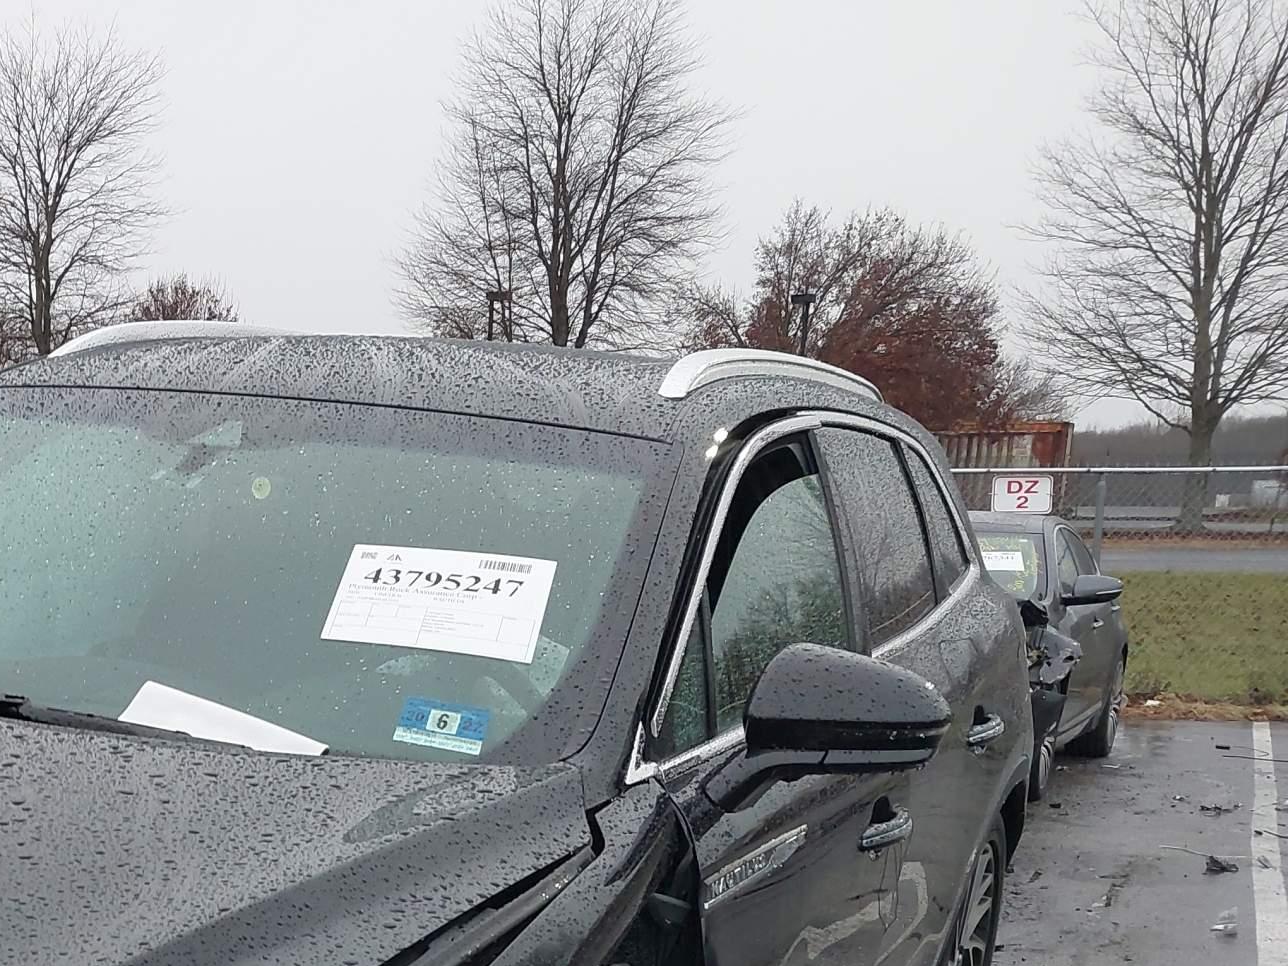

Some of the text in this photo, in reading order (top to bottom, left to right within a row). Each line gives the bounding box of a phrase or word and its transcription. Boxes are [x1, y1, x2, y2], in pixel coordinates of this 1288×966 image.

[1007, 480, 1039, 494] DZ
[1015, 495, 1029, 509] 2
[364, 567, 525, 598] 43795247
[436, 713, 450, 730] 6
